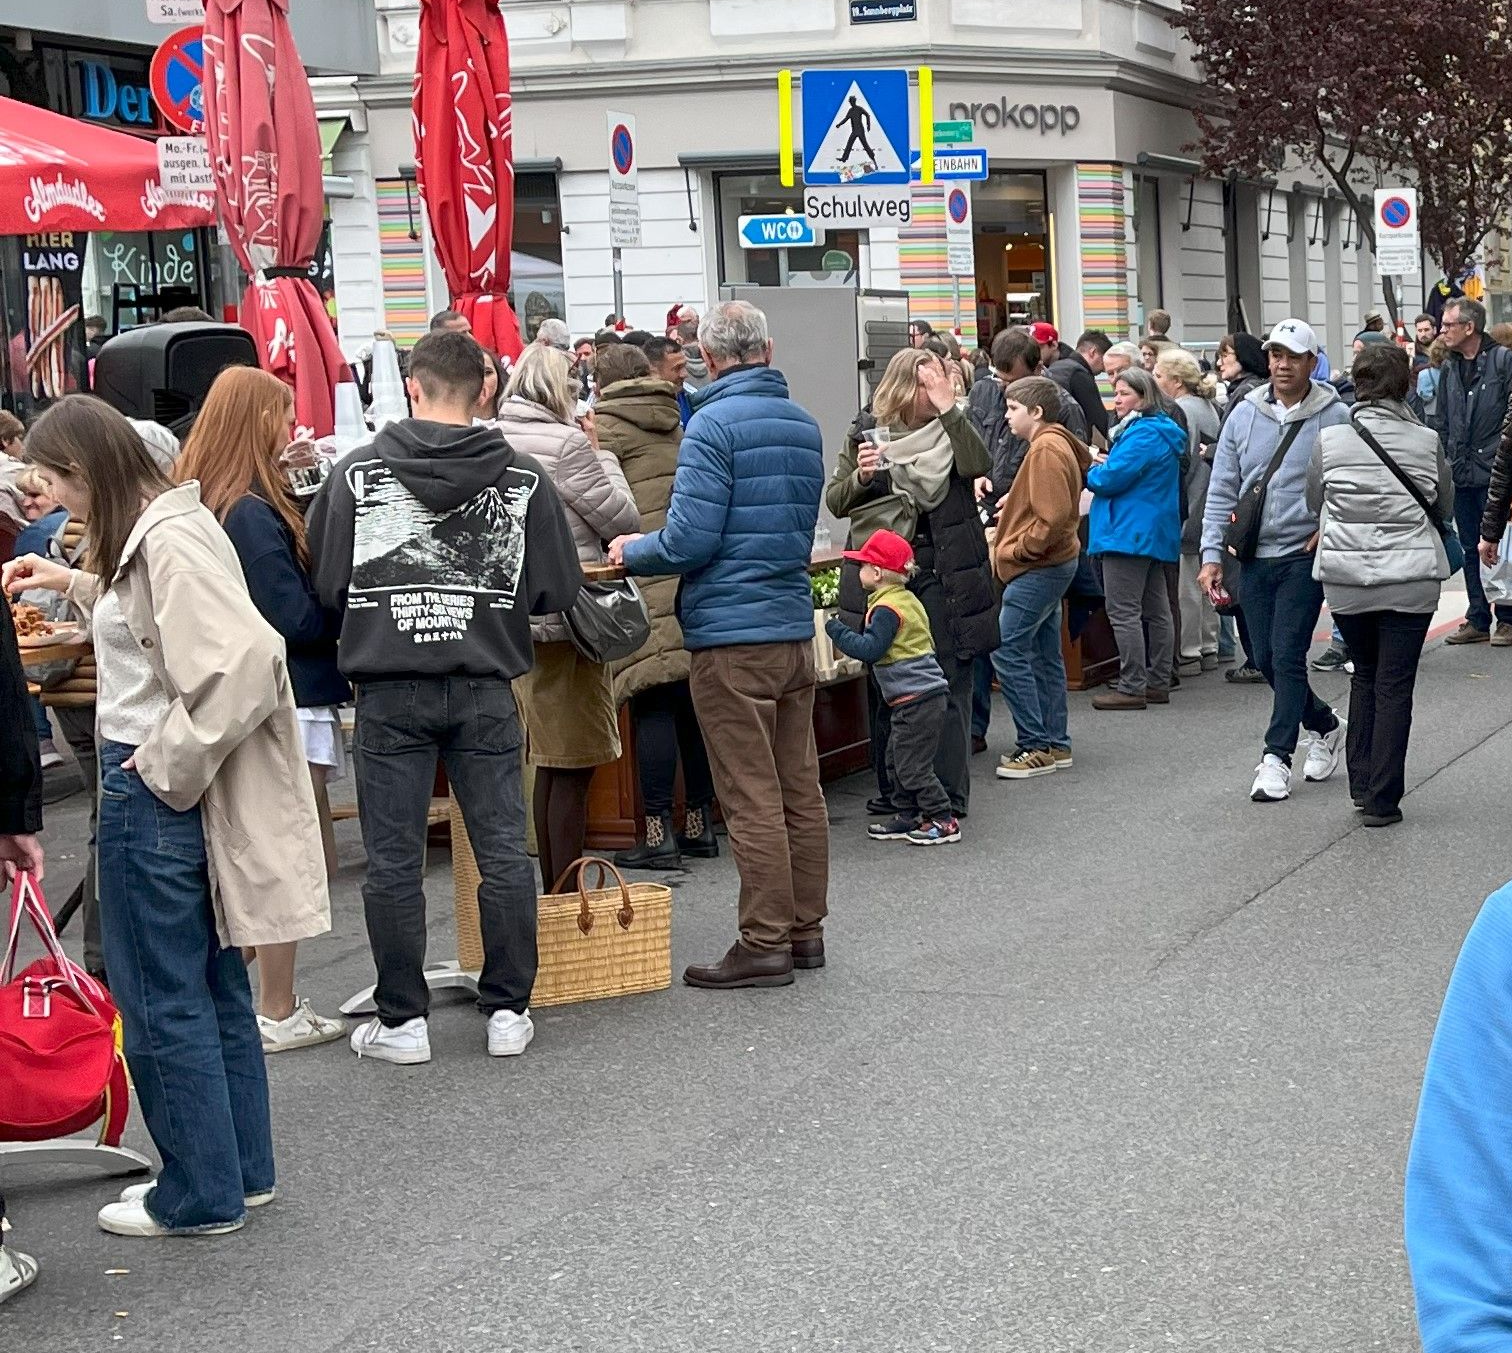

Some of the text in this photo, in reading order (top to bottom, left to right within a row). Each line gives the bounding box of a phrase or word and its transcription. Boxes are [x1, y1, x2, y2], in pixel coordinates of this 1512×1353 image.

[84, 61, 153, 123] Der
[950, 96, 1080, 137] prokopp
[934, 158, 978, 171] EINBAHN
[170, 175, 187, 185] mit
[24, 173, 107, 223] Almdudler
[806, 194, 911, 223] Schulweg
[27, 232, 74, 248] HIER
[762, 222, 787, 240] WC
[24, 252, 79, 271] LANG
[390, 592, 422, 607] FROM
[397, 618, 414, 632] OF
[415, 616, 452, 630] MOUNT
